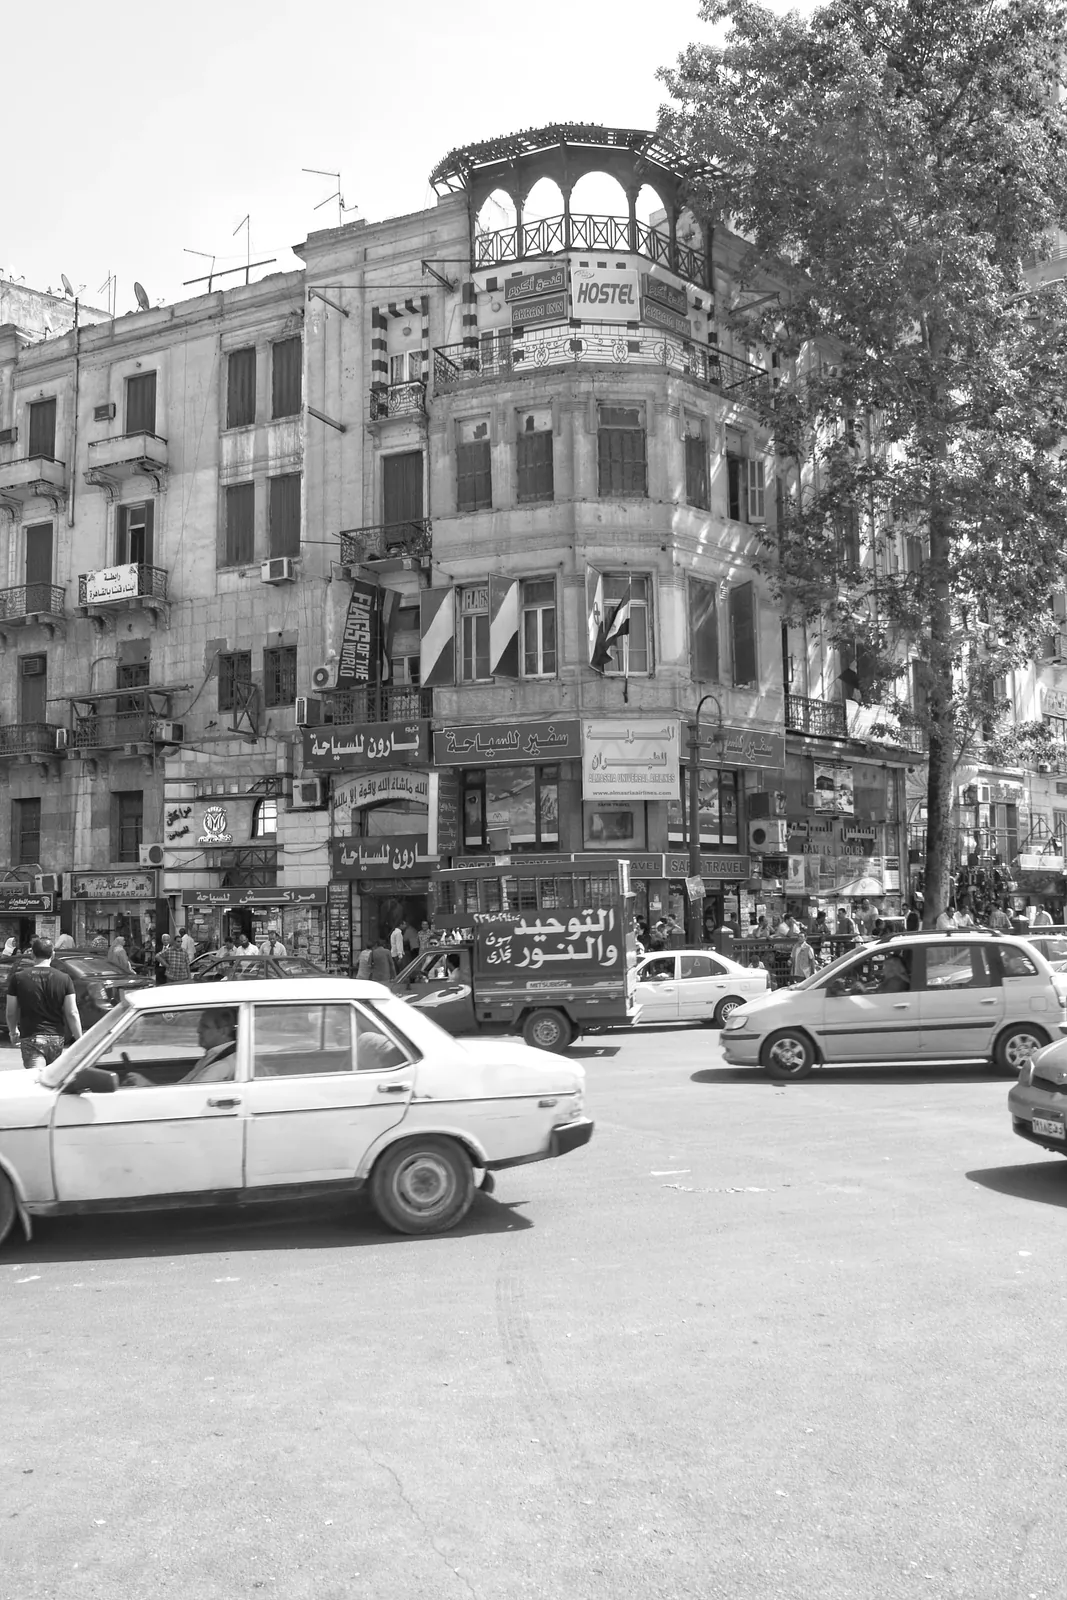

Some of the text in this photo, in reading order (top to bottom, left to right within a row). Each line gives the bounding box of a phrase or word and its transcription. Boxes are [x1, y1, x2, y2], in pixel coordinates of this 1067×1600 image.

[536, 272, 563, 292] فندق
[577, 282, 635, 304] HOSTEL
[513, 301, 563, 321] AKRAM INN
[344, 592, 372, 643] FLAGS
[340, 642, 356, 676] WORLD
[355, 643, 370, 680] OF THE
[310, 731, 419, 760] بارون للسياحة
[445, 726, 569, 757] سفير للسياحة
[618, 773, 648, 783] UNIVERSAL
[650, 773, 676, 783] AIRLINES
[340, 842, 390, 871] للسياحة
[631, 861, 660, 870] AVEL
[705, 861, 745, 873] TRAVEL
[196, 890, 316, 904] مراكش للسياحة
[514, 908, 615, 942] التوحيد
[485, 932, 513, 947] سوق
[514, 935, 618, 969] والنور
